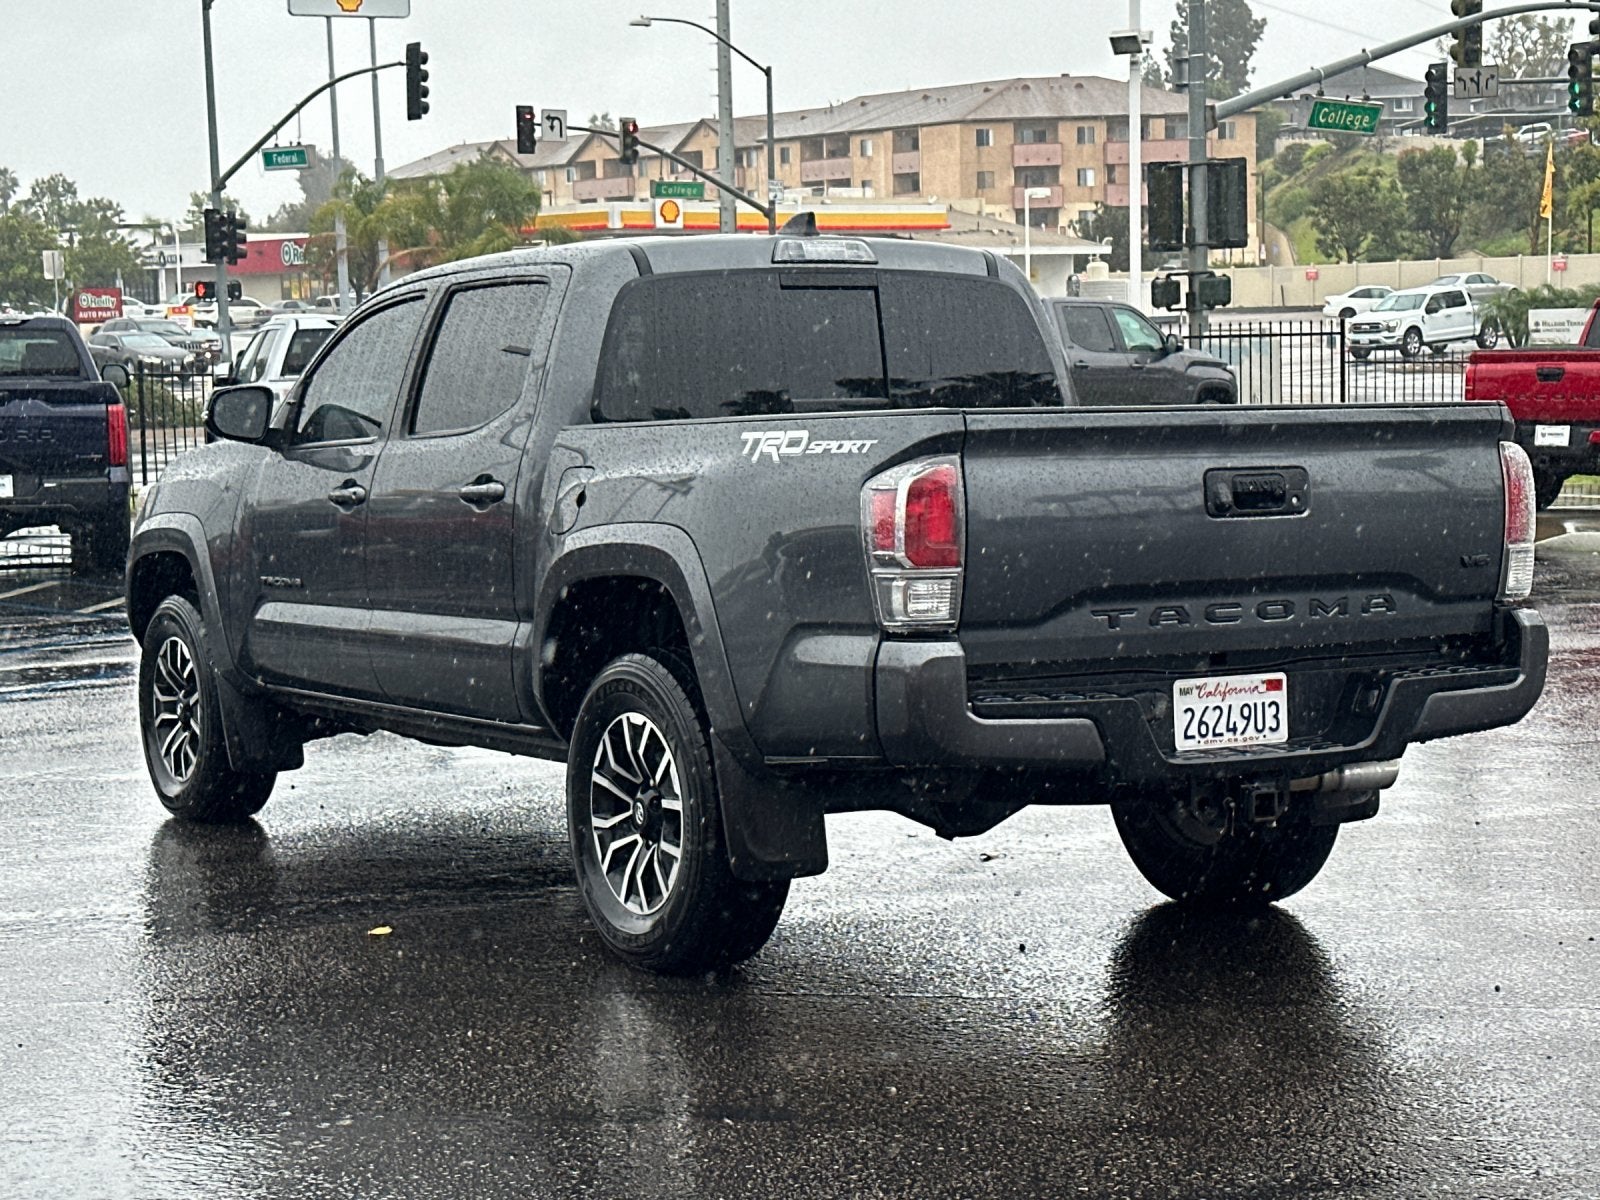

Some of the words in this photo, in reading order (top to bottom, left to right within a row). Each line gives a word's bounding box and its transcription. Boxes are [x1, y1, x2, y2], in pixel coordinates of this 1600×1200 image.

[1319, 107, 1370, 130] College
[272, 152, 298, 164] Federal
[661, 185, 698, 198] College
[281, 241, 306, 266] O'Re
[79, 293, 117, 309] O'Reilly
[79, 310, 97, 319] AUTO
[98, 310, 120, 319] PARTS
[740, 430, 809, 463] TRD
[805, 439, 879, 454] SPORT
[1089, 593, 1398, 631] TACOMA
[1179, 687, 1194, 697] MAY
[1196, 681, 1267, 702] California
[1183, 700, 1281, 741] 26249U3
[1203, 735, 1260, 745] dmv.ca.gov
